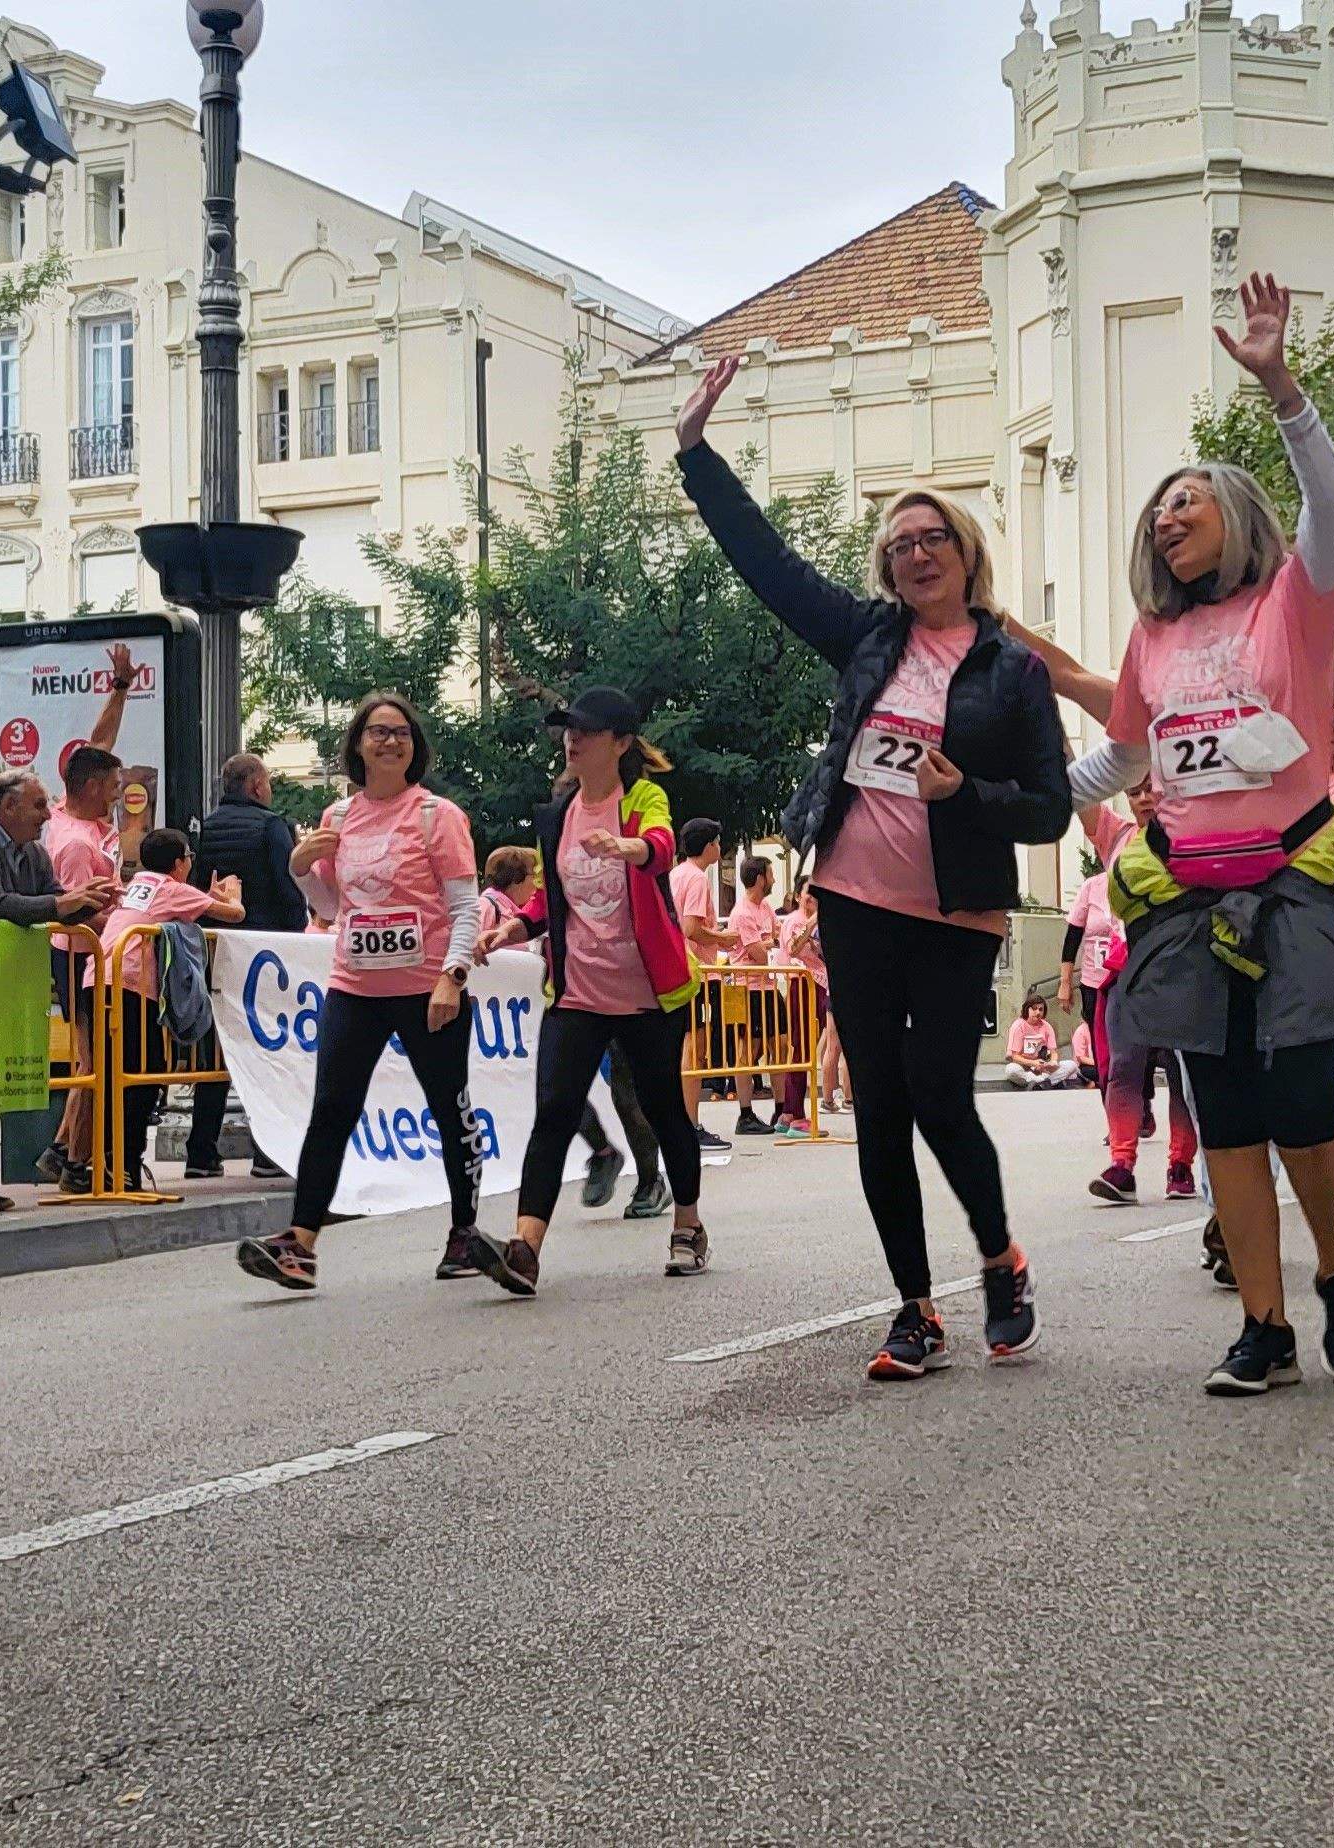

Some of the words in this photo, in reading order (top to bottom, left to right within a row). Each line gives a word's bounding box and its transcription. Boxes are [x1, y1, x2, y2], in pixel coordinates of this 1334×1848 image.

[25, 625, 67, 637] URBAN
[33, 665, 60, 674] Nuevo
[32, 667, 91, 696] MENÚ
[351, 929, 417, 954] 3086
